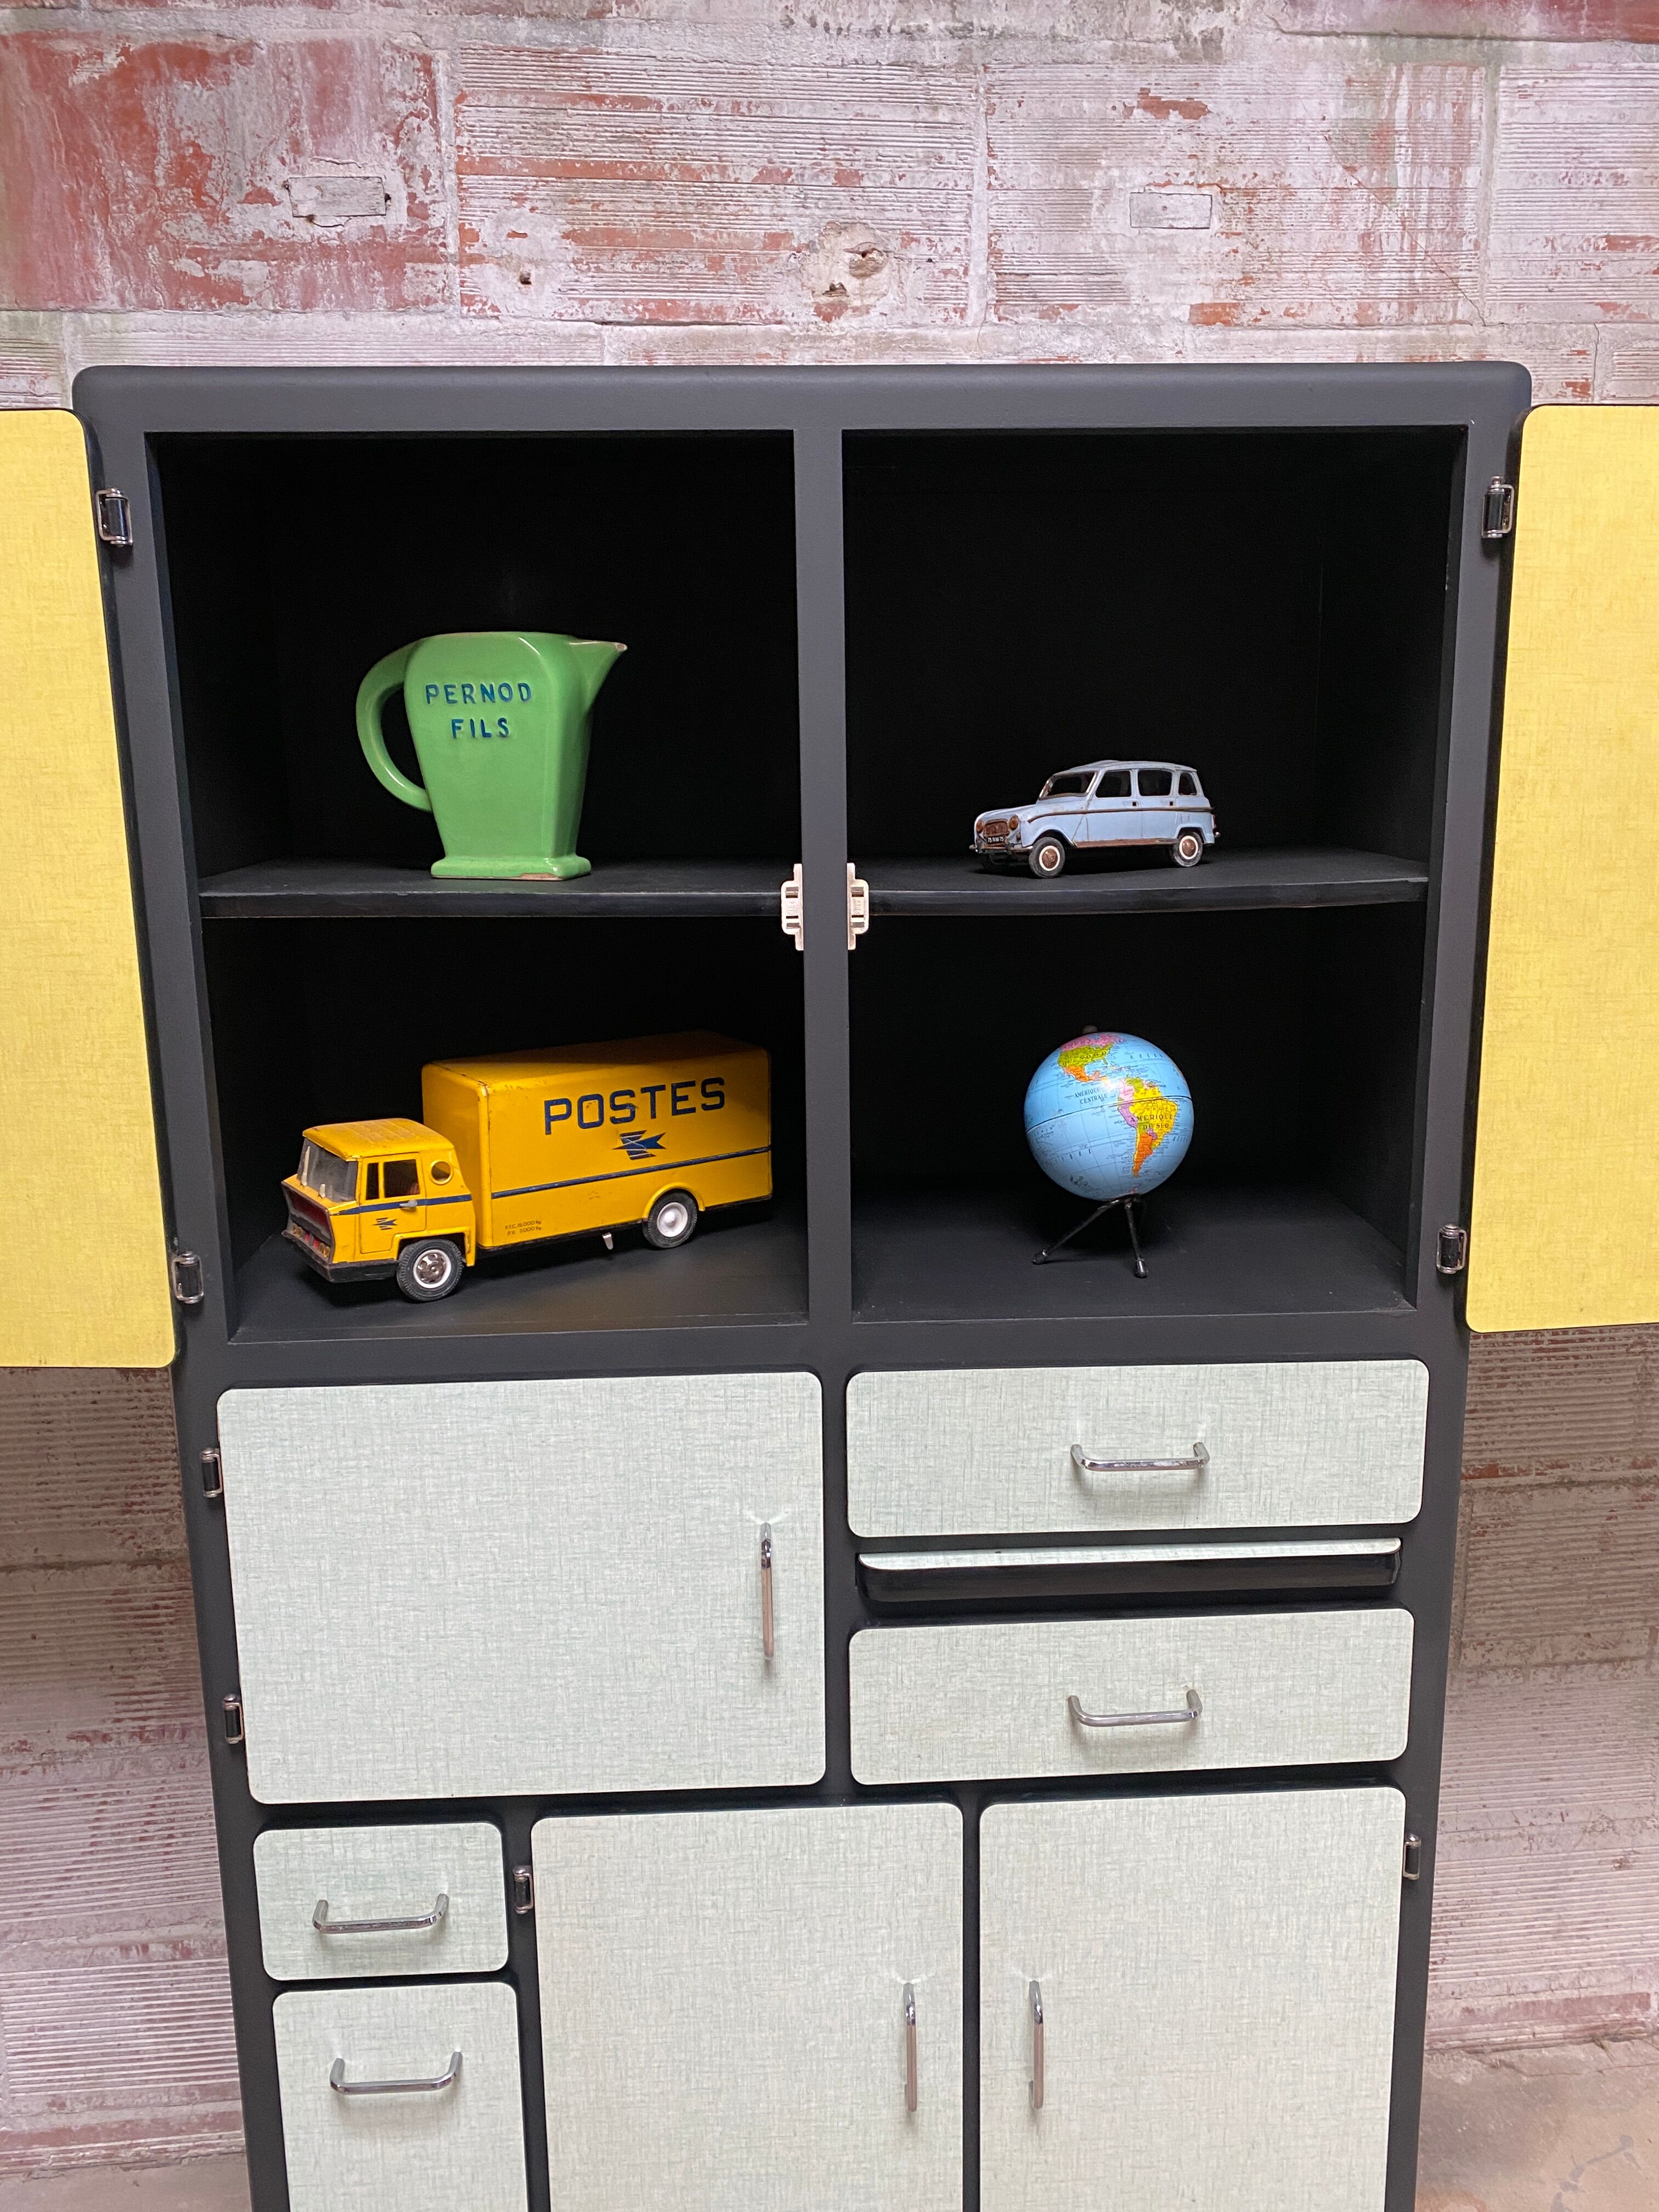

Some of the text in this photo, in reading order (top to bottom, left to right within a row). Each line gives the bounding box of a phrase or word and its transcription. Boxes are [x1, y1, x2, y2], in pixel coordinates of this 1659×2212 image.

[426, 682, 533, 705] PERNOD
[451, 717, 510, 738] FILS
[1074, 1087, 1101, 1098] AMÉRIQUE
[1080, 1094, 1108, 1104] CENTRALE
[544, 1076, 725, 1136] POSTES
[1130, 1114, 1173, 1122] AMÉRIQUE
